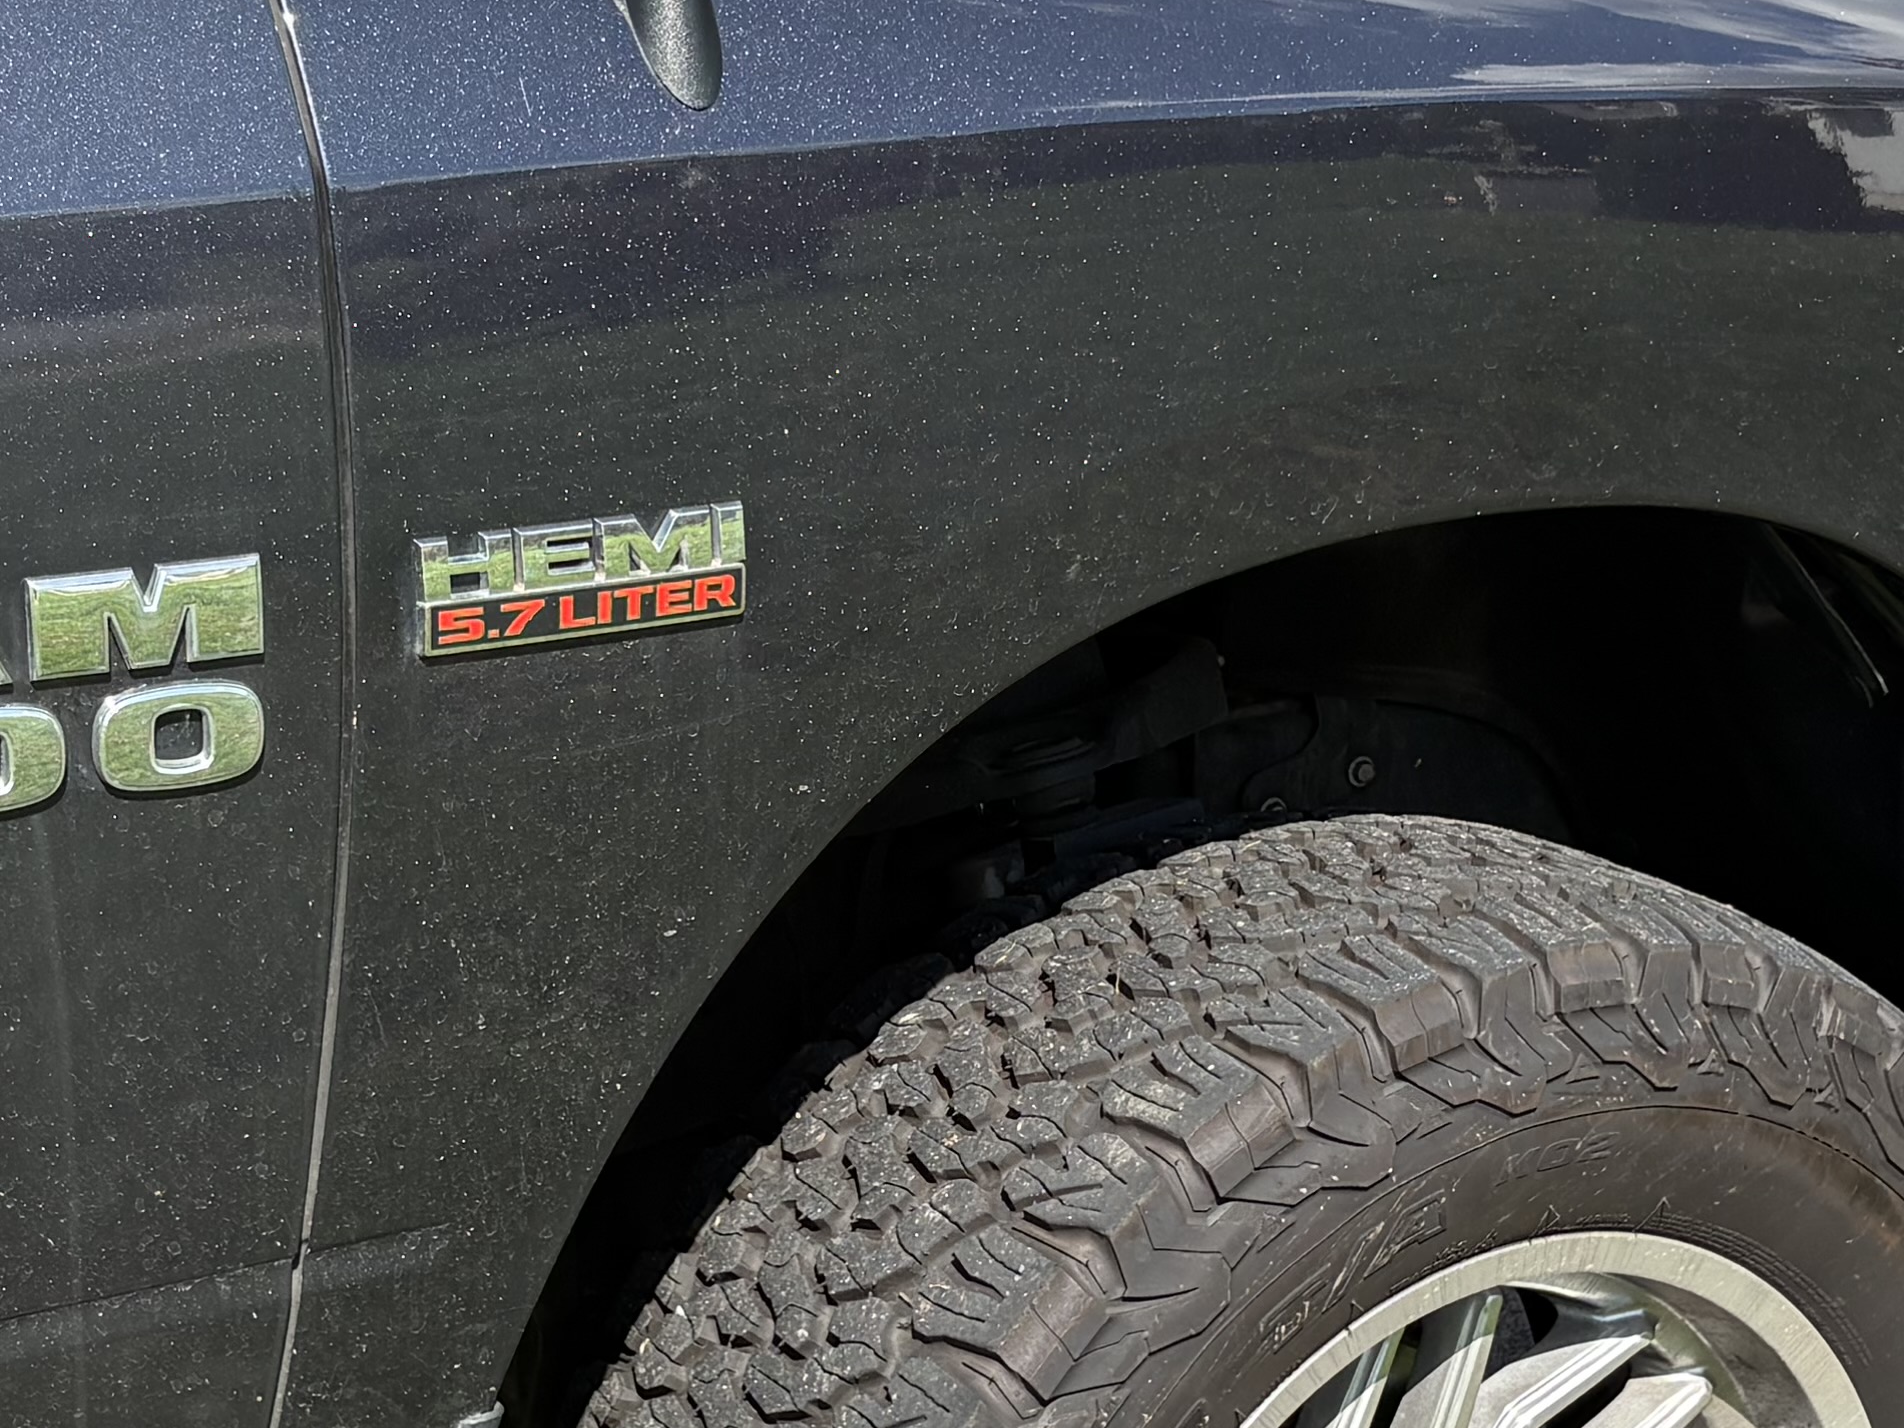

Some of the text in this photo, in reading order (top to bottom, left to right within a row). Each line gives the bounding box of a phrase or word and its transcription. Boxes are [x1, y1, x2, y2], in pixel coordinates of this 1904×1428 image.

[413, 500, 744, 602] HEMI
[437, 574, 736, 645] 5.7 LITER
